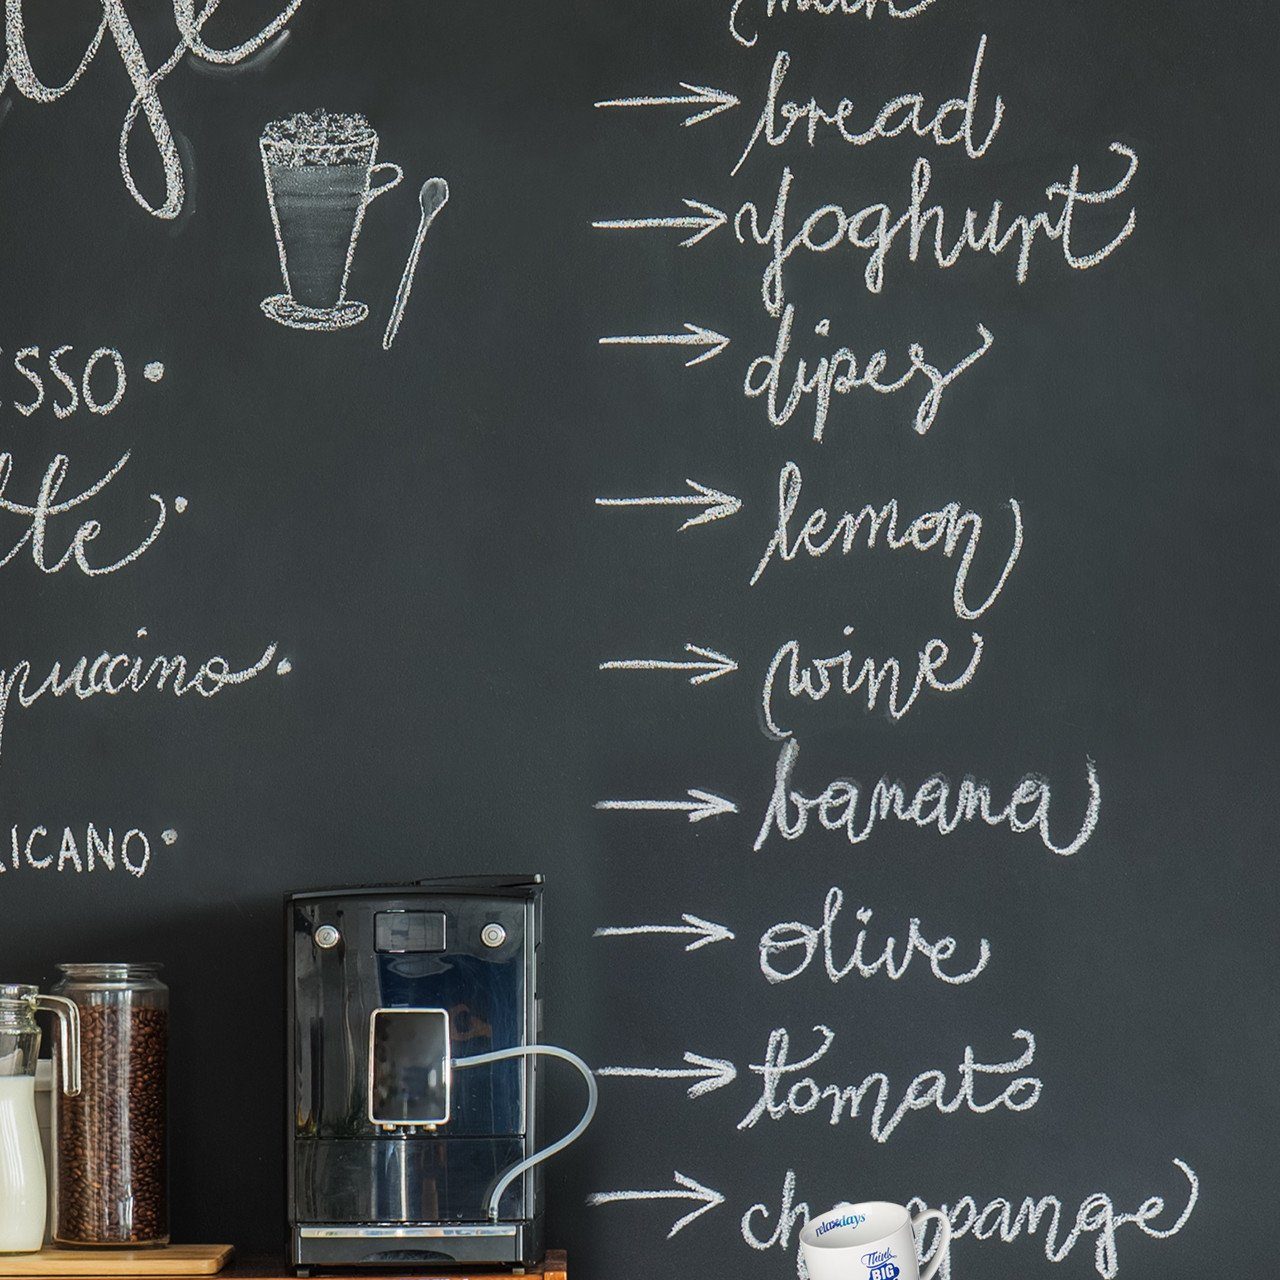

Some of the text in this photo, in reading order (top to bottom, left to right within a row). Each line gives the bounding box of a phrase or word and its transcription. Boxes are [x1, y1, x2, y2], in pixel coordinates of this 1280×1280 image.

[730, 34, 1005, 176] bread
[0, 345, 127, 419] SSO
[750, 461, 1023, 620] lemon
[762, 625, 984, 738] wine
[753, 738, 1101, 856] banana
[0, 823, 151, 878] ICANO
[759, 886, 991, 985] olive
[736, 1024, 1044, 1143] tomato
[815, 1213, 866, 1237] relaxdays
[861, 1247, 897, 1268] Think
